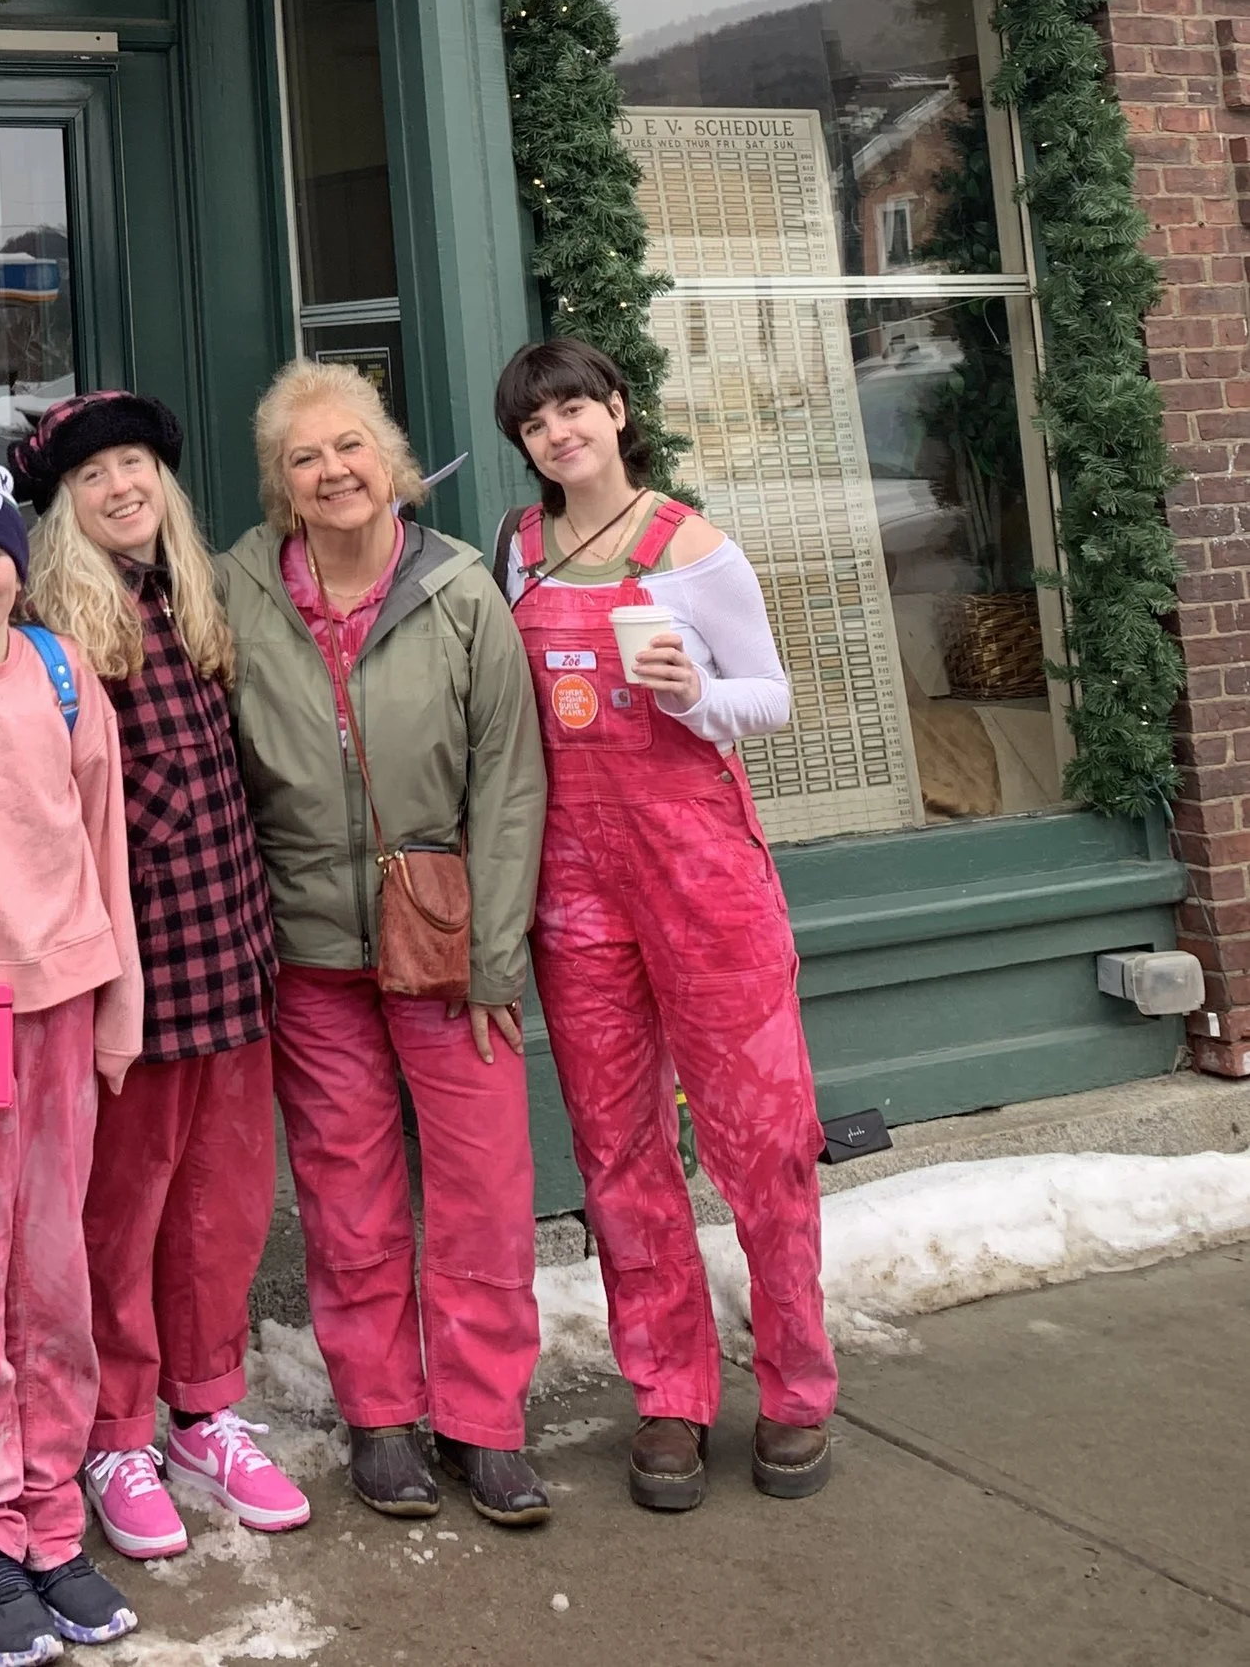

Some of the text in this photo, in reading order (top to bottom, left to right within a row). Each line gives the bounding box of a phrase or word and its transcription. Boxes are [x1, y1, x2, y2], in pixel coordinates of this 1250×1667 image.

[694, 119, 795, 137] SCHEDULE
[627, 139, 652, 148] TUES
[657, 139, 681, 148] WED
[686, 139, 710, 148] THUR
[745, 140, 764, 149] SAT
[773, 141, 794, 149] SUN
[561, 654, 581, 667] Zoë
